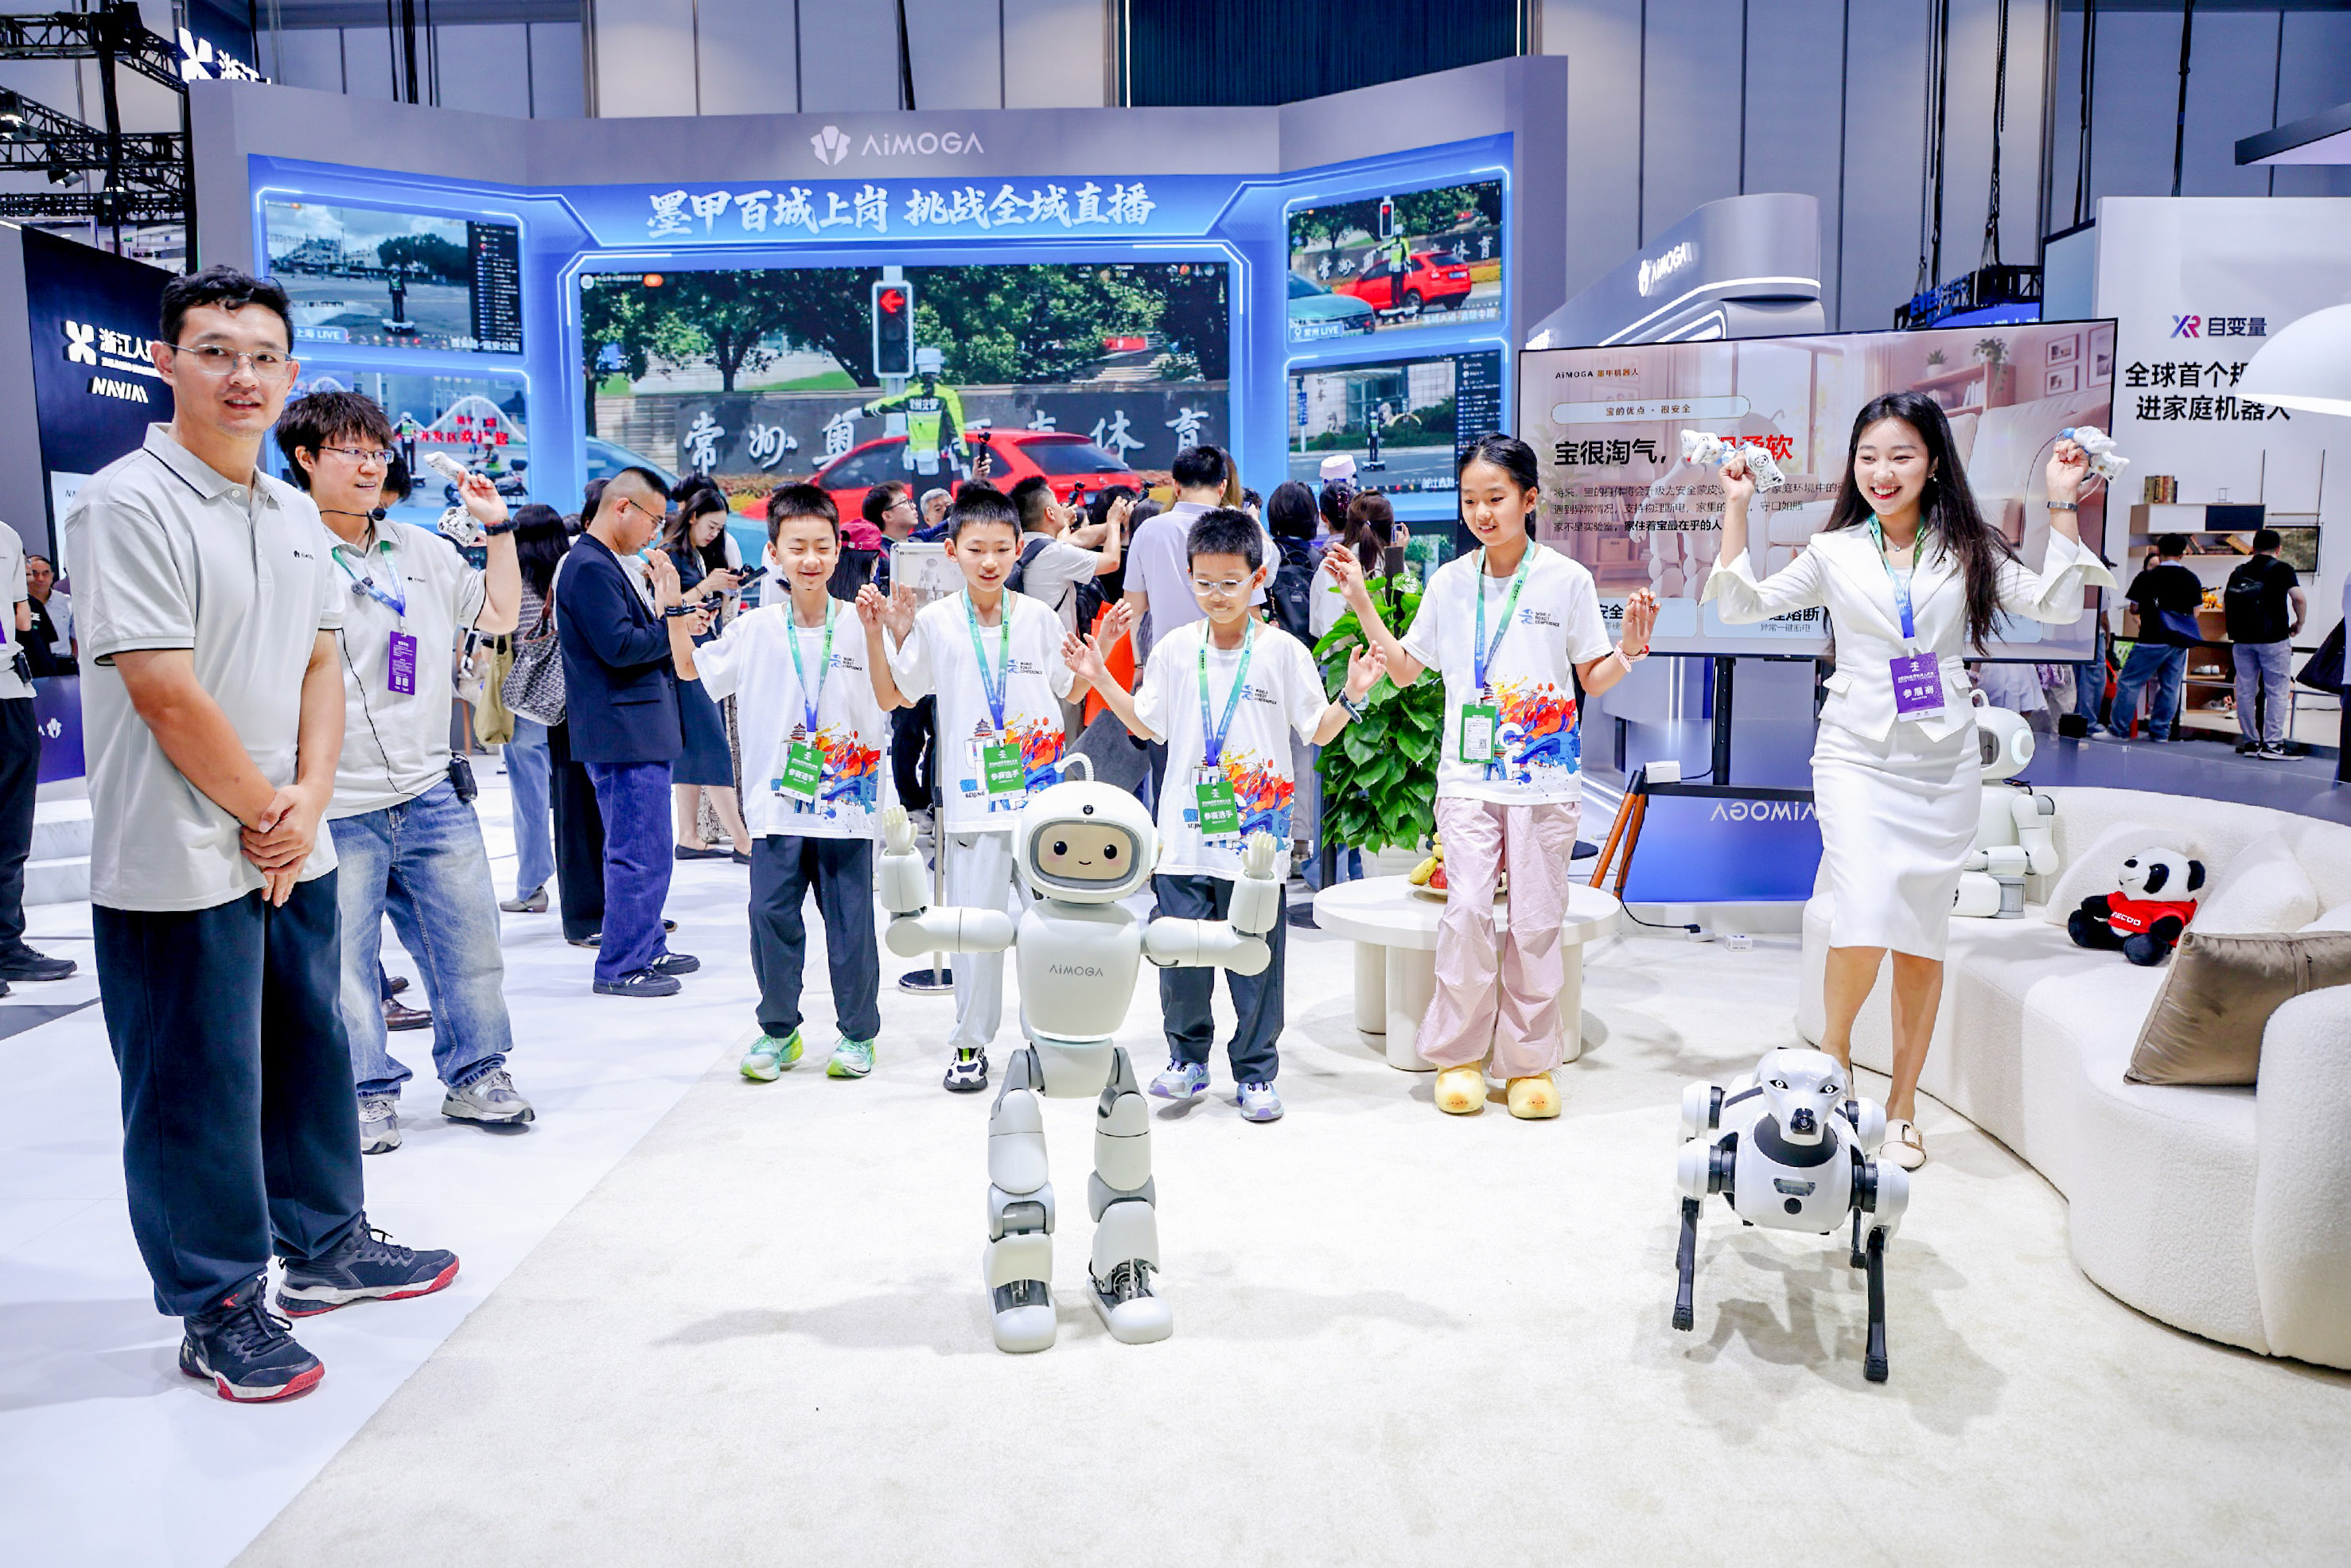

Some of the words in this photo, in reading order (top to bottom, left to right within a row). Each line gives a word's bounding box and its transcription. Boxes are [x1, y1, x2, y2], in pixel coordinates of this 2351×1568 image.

[861, 131, 984, 155] AiMOGA
[648, 184, 889, 239] 墨甲百城上岗
[902, 182, 1157, 232] 挑战全域直播
[1321, 325, 1339, 337] LIVE
[2208, 317, 2267, 337] 自变量
[317, 330, 341, 340] LIVE
[1555, 371, 1594, 379] AiMOGA
[2136, 395, 2291, 421] 进家庭机器人
[1902, 685, 1934, 698] 参展商
[1203, 809, 1234, 821] 参赛选手
[1049, 964, 1103, 977] AiMOGA
